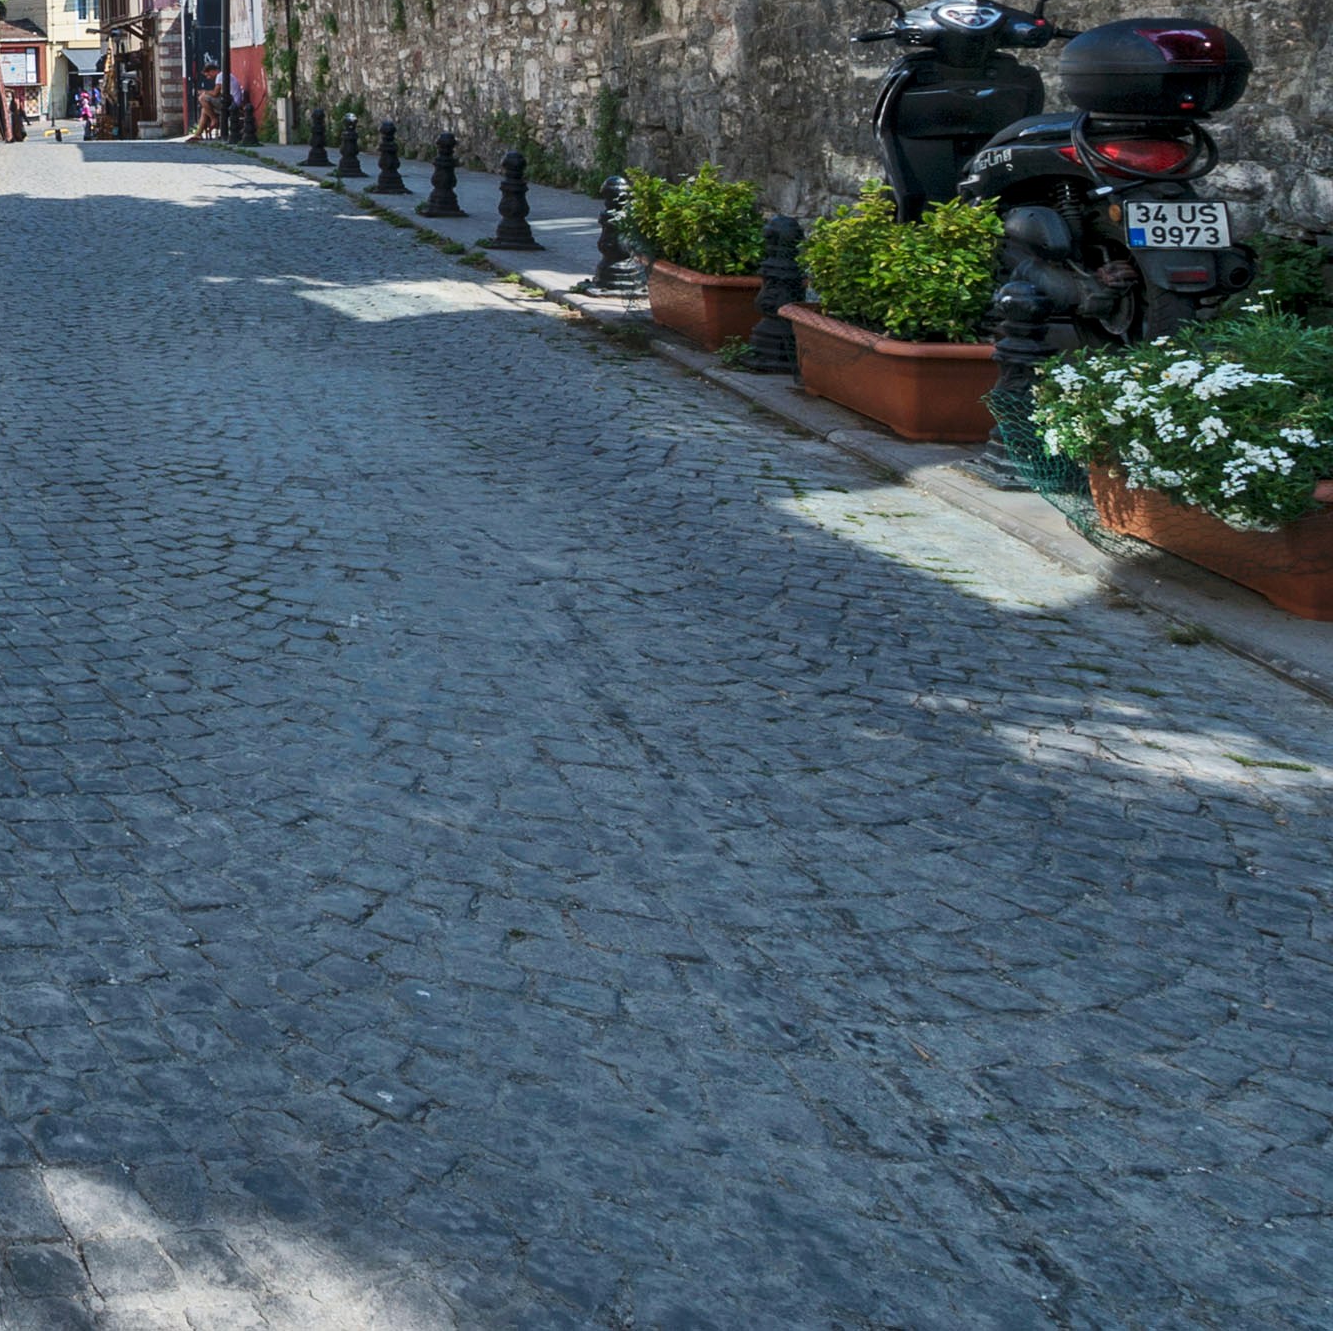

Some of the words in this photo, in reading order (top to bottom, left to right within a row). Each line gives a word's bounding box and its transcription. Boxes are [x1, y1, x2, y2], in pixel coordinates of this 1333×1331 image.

[1137, 205, 1168, 224] 34
[1177, 205, 1218, 224] US
[1152, 226, 1221, 245] 9973
